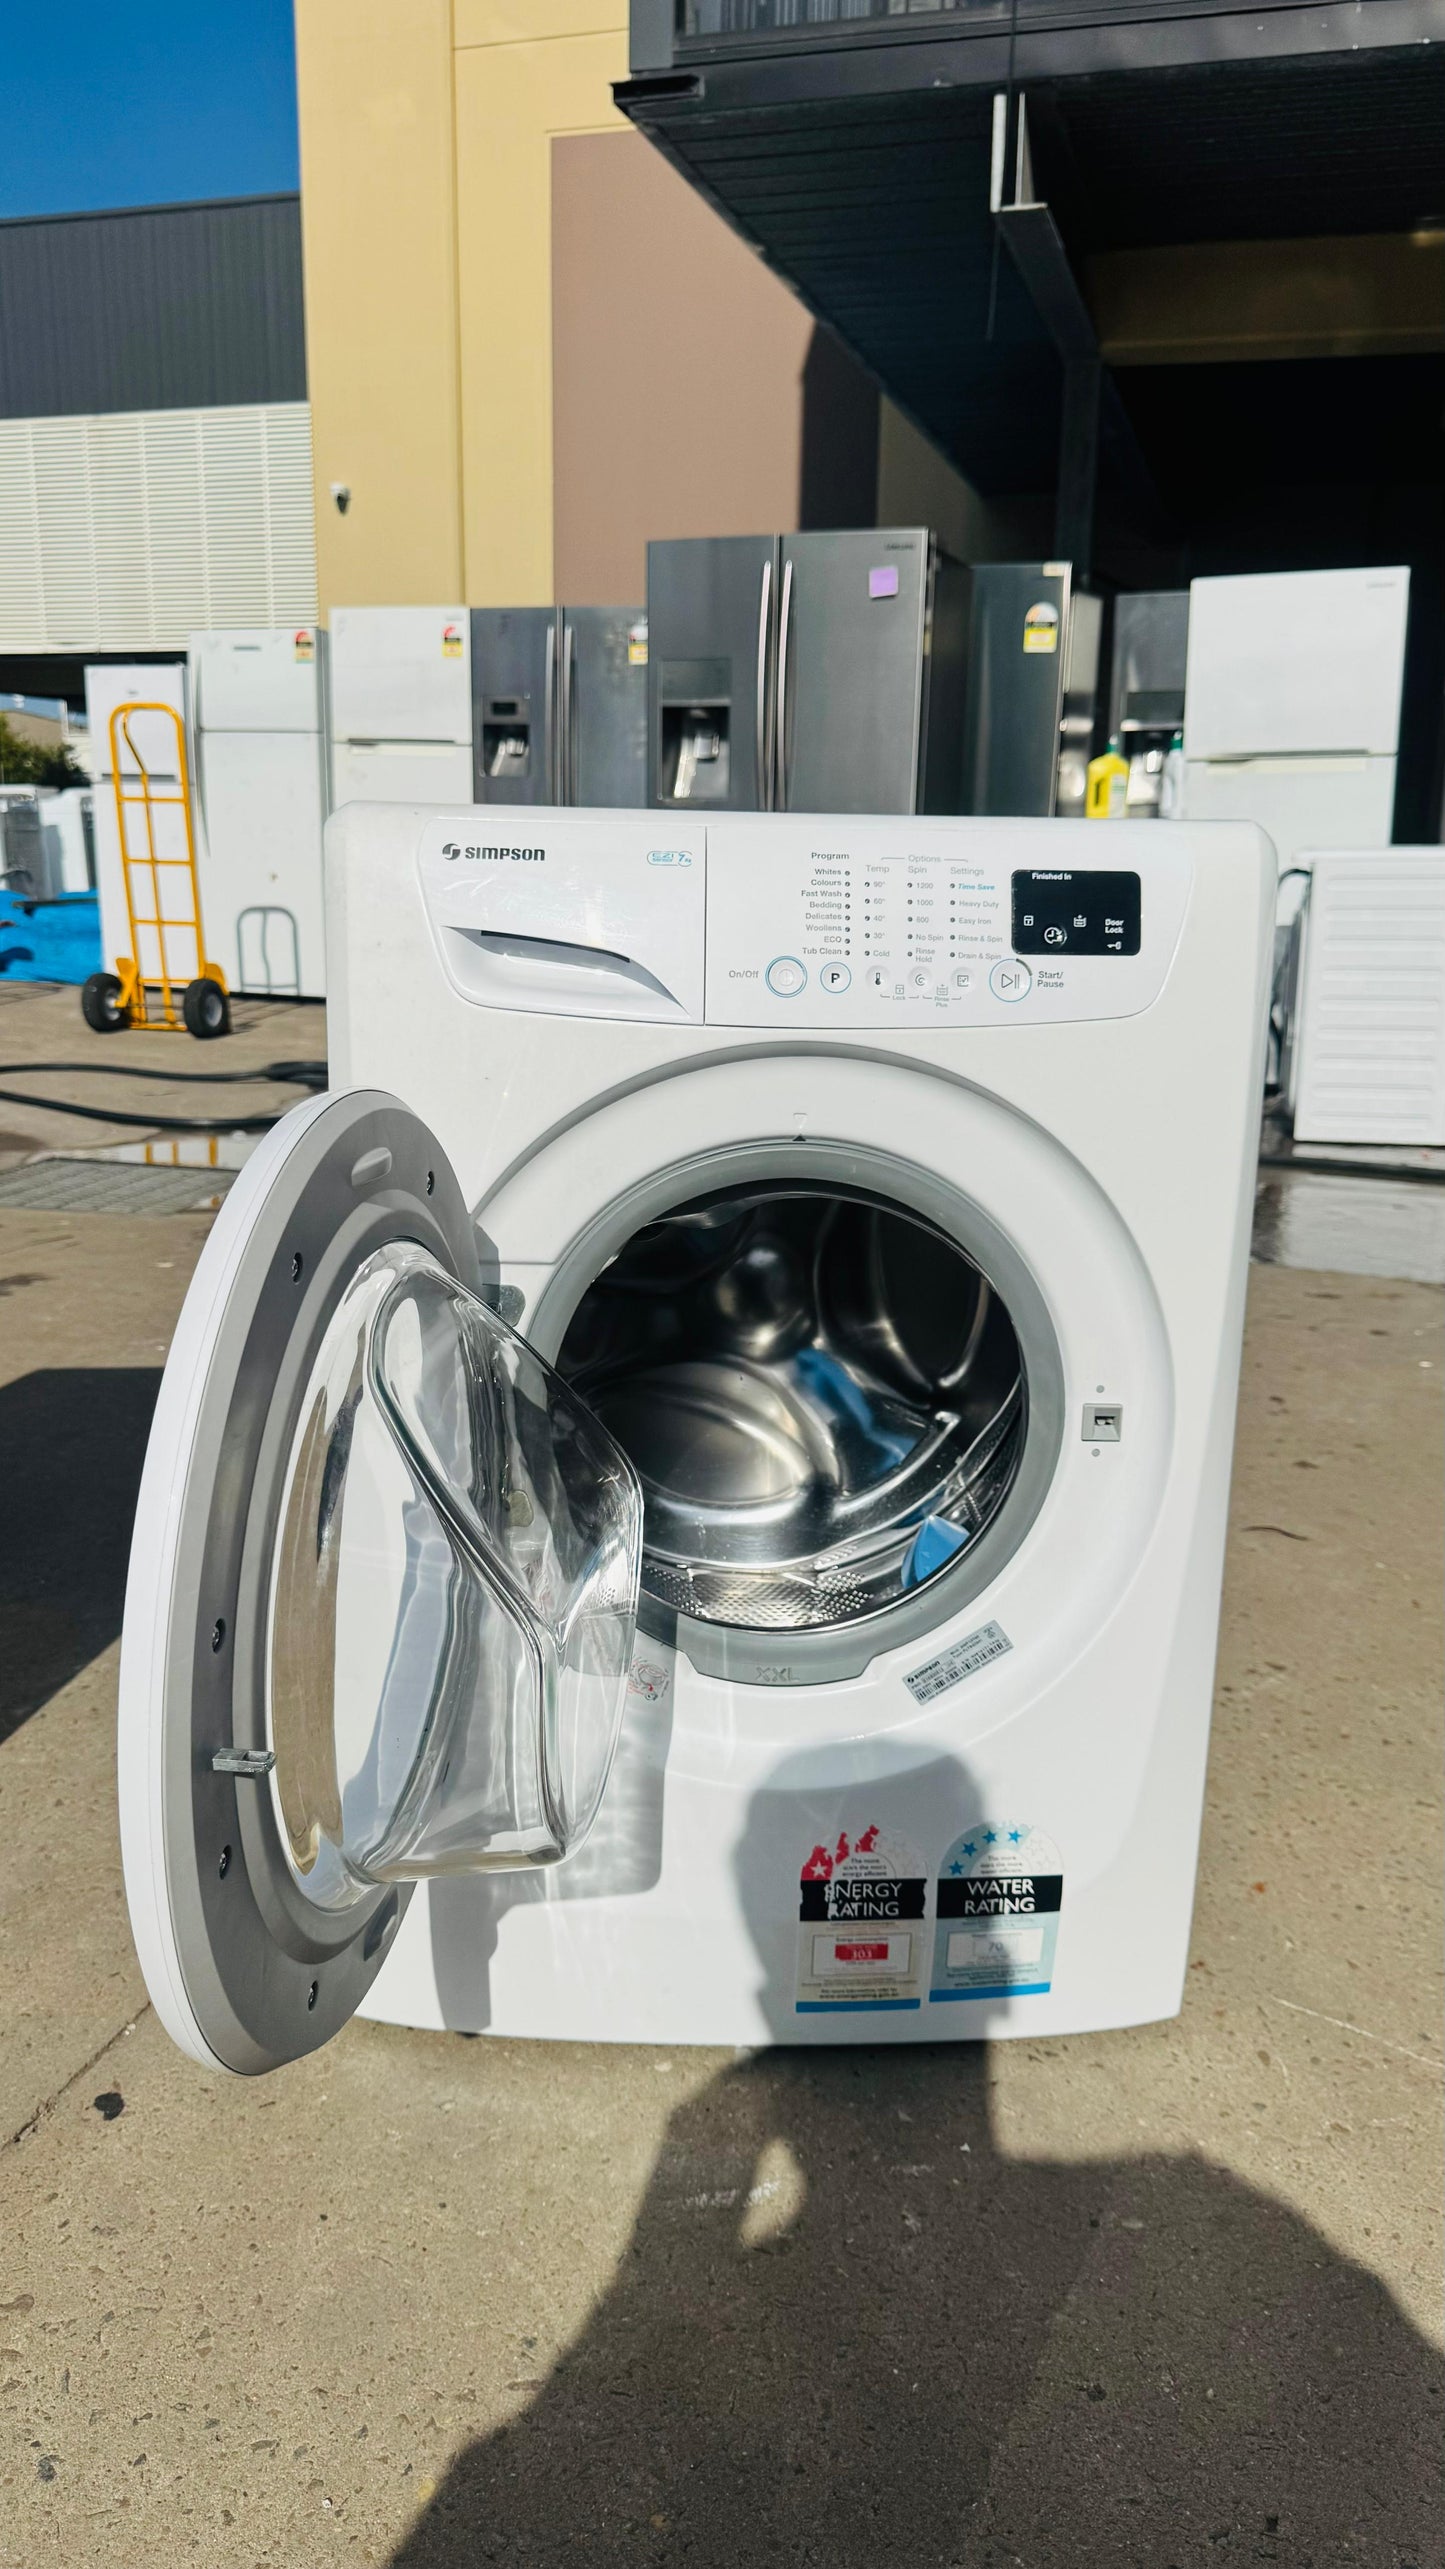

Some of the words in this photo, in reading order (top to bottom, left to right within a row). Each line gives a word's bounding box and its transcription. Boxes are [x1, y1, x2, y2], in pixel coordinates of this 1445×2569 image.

[465, 846, 545, 861] SIMPSON
[811, 852, 850, 861] Program
[908, 854, 941, 864] Options
[814, 868, 842, 876] Whites
[865, 864, 890, 873] Temp
[908, 866, 928, 874] Spin
[950, 867, 985, 877] Settings
[1032, 872, 1063, 880] Finished
[810, 879, 842, 887] Colours
[801, 889, 819, 897] Fast
[820, 890, 842, 898] Wash
[809, 901, 842, 910] Bedding
[916, 899, 934, 907] 1000
[959, 899, 981, 909] Heavy
[982, 900, 999, 909] Duty
[805, 912, 842, 920] Delicates
[958, 917, 976, 926] Easy
[977, 917, 992, 925] Iron
[1105, 918, 1124, 926] Door
[805, 924, 842, 932] Woollens
[1105, 926, 1124, 934] Lock
[823, 935, 842, 943] ECO
[916, 933, 926, 941] No
[927, 934, 944, 943] Spin
[958, 934, 978, 942] Rinse
[986, 935, 1003, 944] Spin
[802, 947, 818, 955] Tub
[819, 947, 842, 955] Clean
[873, 949, 890, 957] Cold
[915, 947, 936, 955] Rinse
[915, 955, 933, 963] Hold
[958, 951, 977, 959] Drain
[985, 952, 1002, 961] Spin
[728, 970, 759, 979] On/Off
[831, 973, 840, 983] P
[1038, 970, 1064, 979] Start/
[1037, 979, 1065, 988] Pause
[755, 1666, 801, 1682] XXL
[967, 1878, 1035, 1896] WATER
[964, 1896, 1036, 1915] RATING
